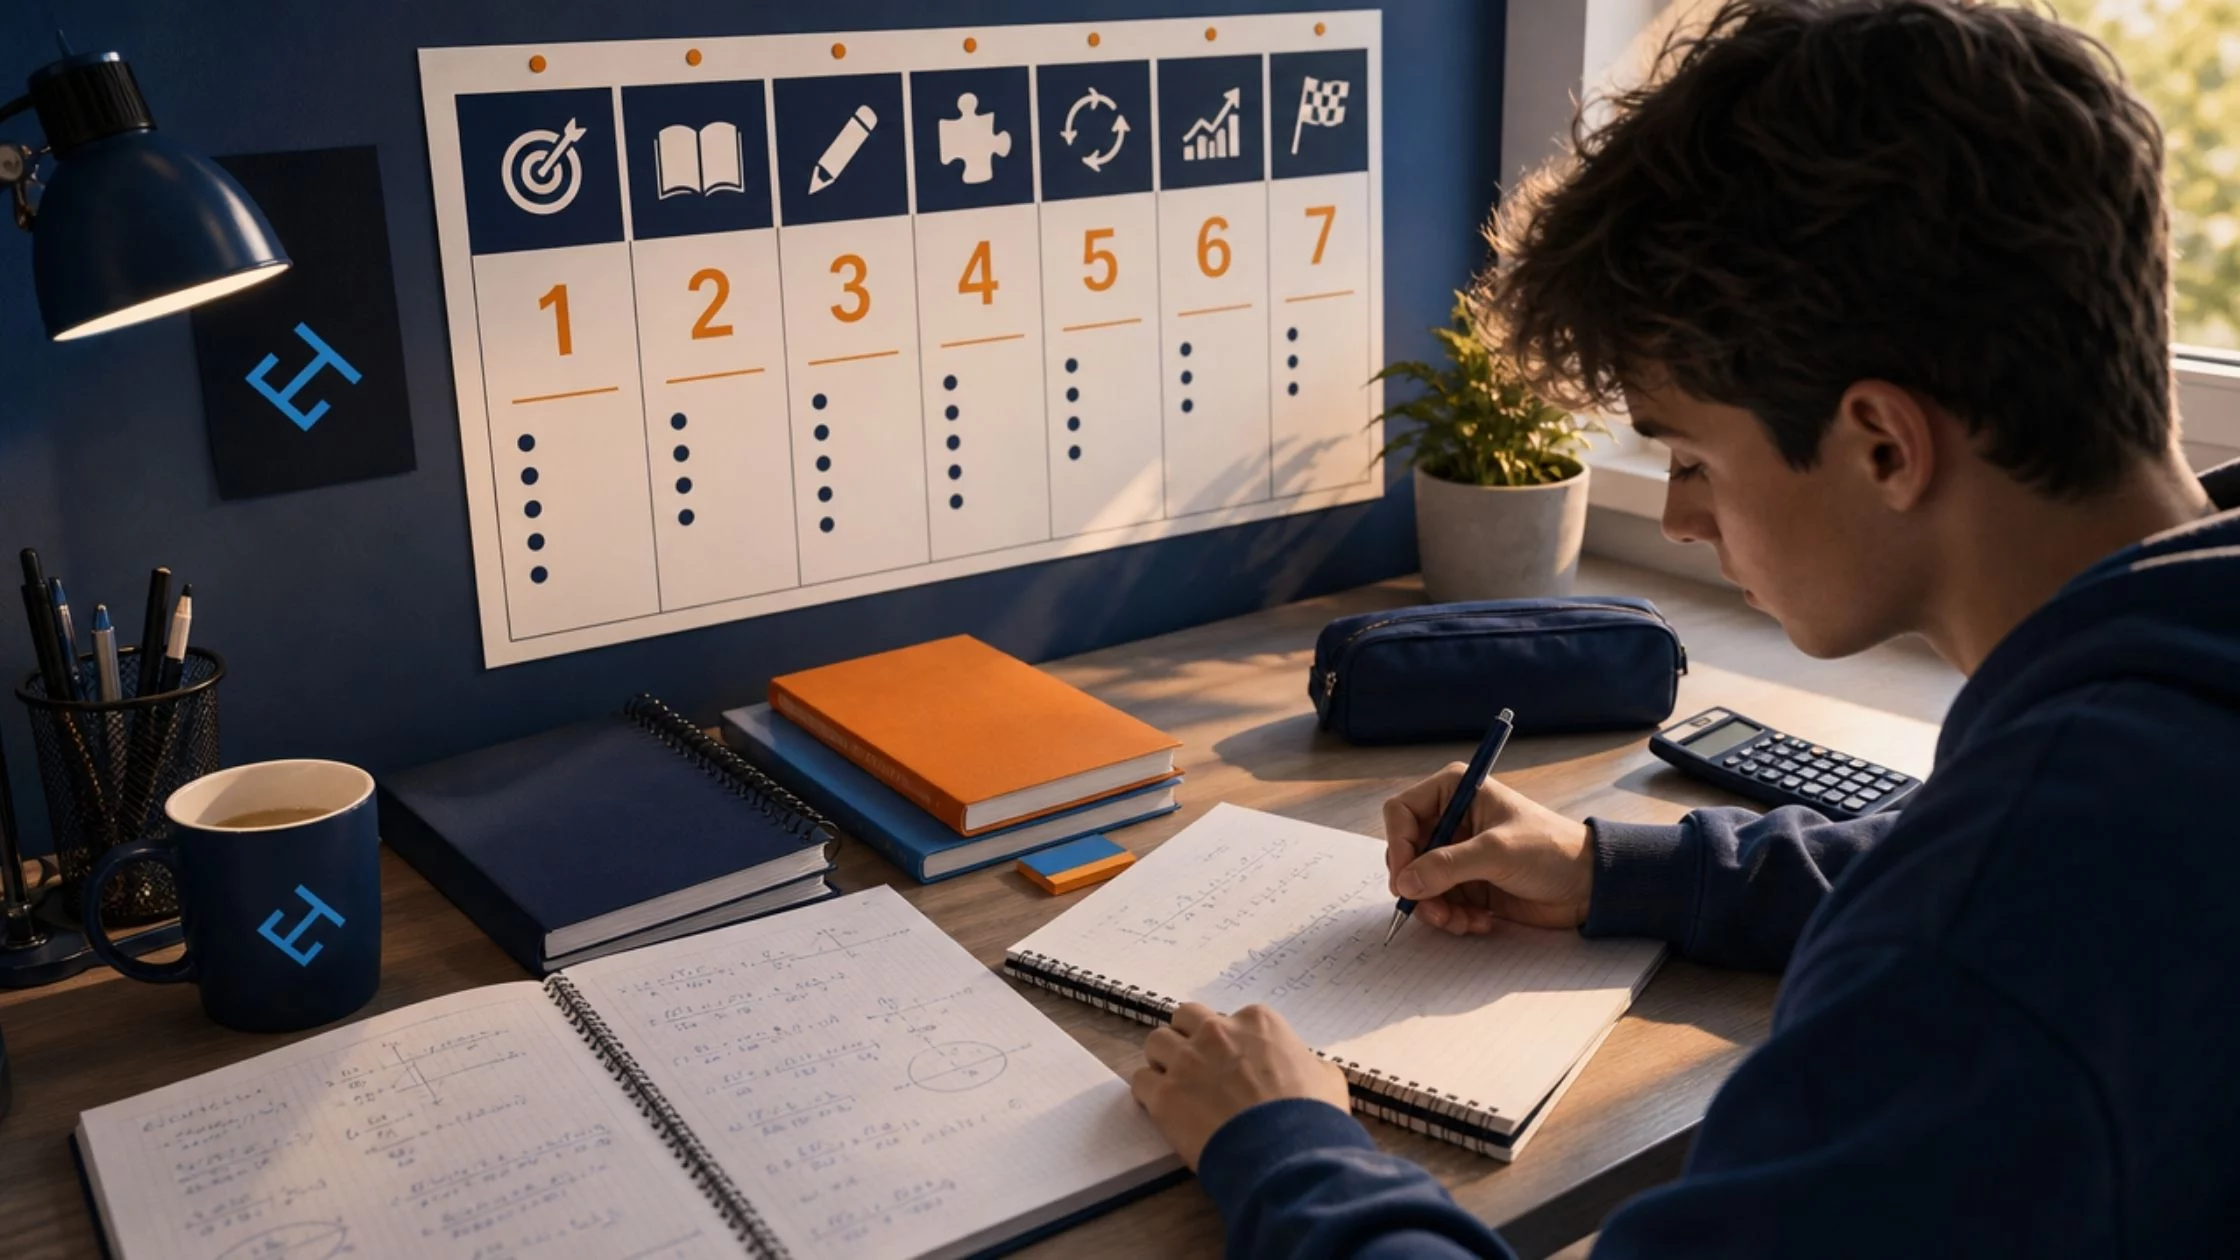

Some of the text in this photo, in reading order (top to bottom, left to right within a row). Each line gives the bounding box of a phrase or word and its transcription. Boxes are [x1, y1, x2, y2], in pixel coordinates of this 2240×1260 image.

[1083, 228, 1118, 291] 5
[1197, 216, 1231, 277] 6
[1305, 205, 1336, 264] 7
[688, 267, 732, 339] 2
[829, 253, 870, 322] 3
[956, 241, 998, 305] 4
[538, 284, 571, 355] 1
